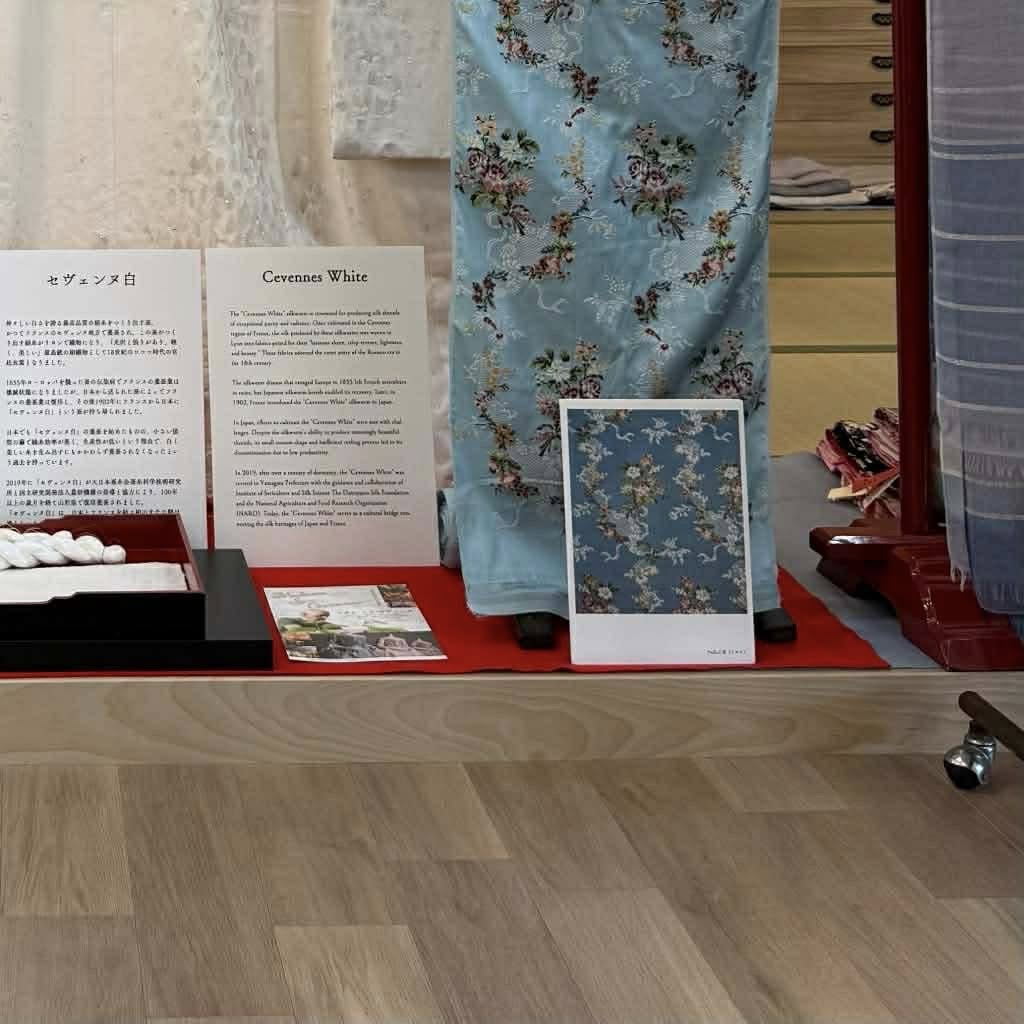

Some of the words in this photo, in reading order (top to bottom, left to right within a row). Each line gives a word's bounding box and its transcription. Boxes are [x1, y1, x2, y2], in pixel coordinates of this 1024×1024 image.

[47, 272, 136, 287] セヴェンヌ白
[262, 270, 323, 283] Cevennes
[327, 270, 368, 283] White
